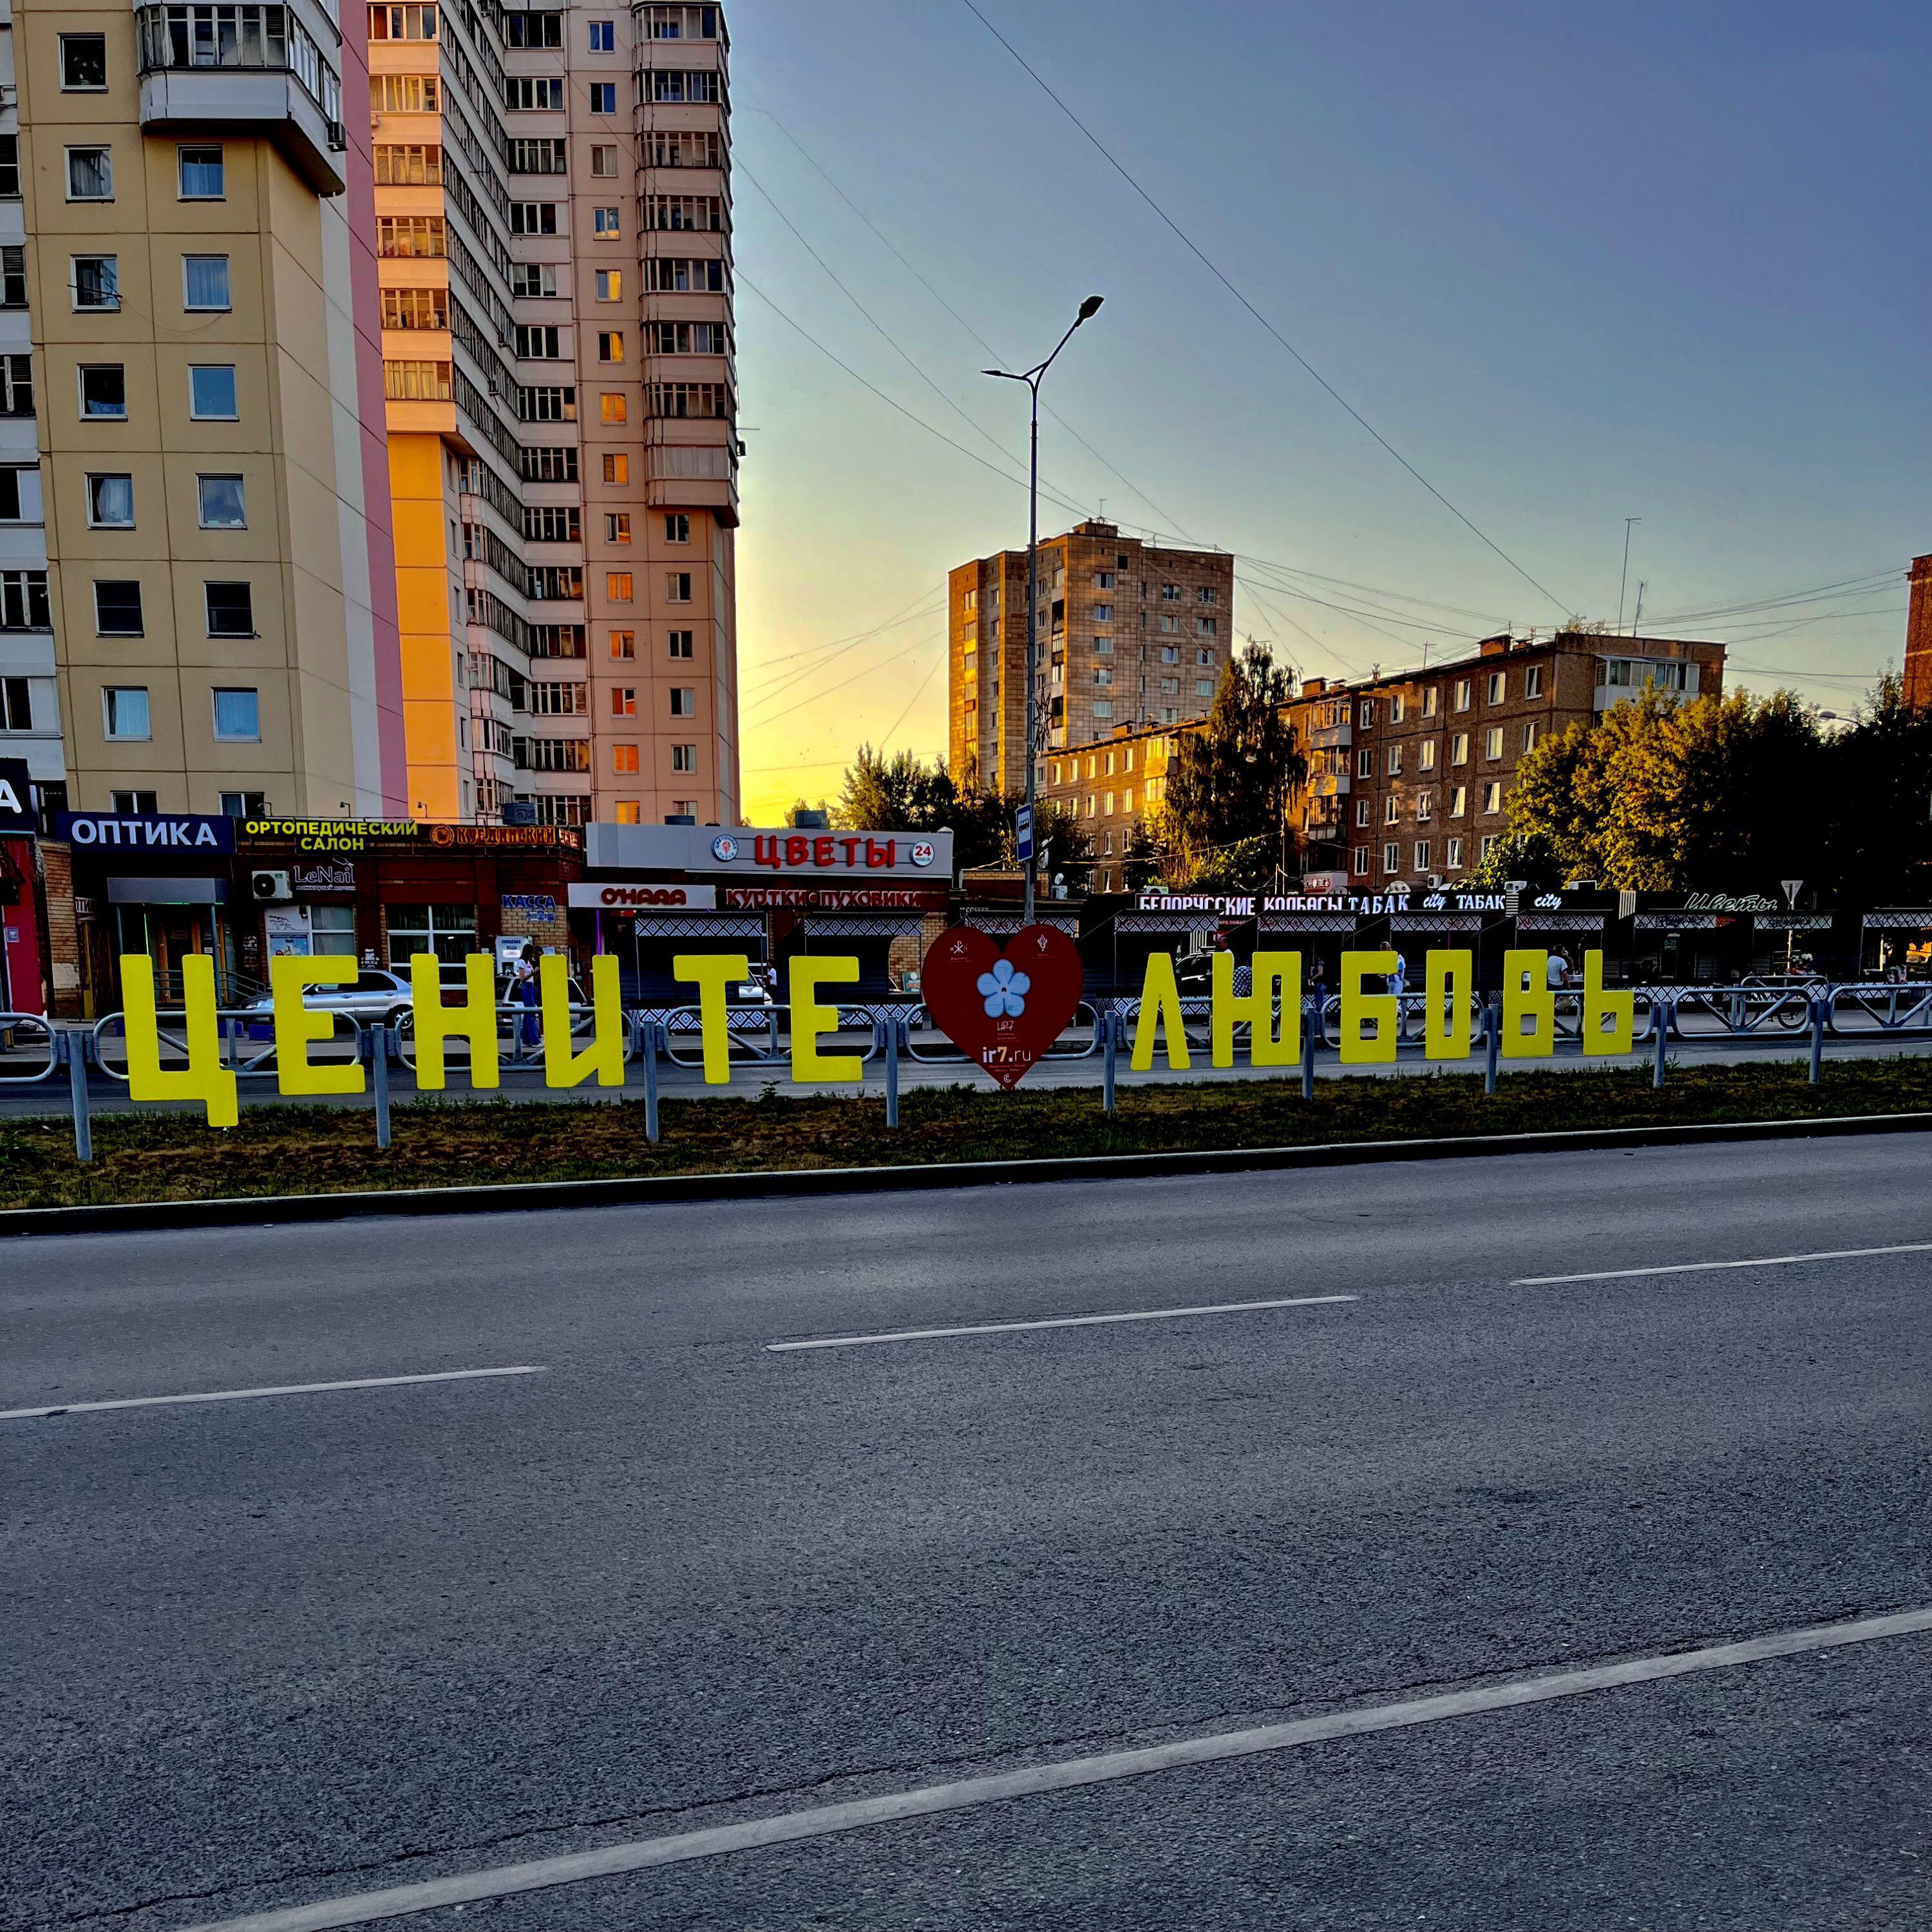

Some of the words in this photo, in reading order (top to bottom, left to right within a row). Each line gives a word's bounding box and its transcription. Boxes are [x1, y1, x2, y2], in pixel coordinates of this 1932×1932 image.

[71, 819, 218, 846] ОПТИКА
[245, 820, 418, 837] ОРТОПЕДИЧЕСКИЙ
[457, 826, 556, 844] КУЕДИНСКИЙ
[301, 837, 364, 850] САЛОН
[755, 835, 896, 868] ЦВЕТЫ
[915, 846, 931, 856] 24
[293, 866, 355, 883] LeNail
[502, 895, 557, 909] КАССА
[726, 889, 808, 909] КУРТКИ
[819, 891, 923, 910] ПУХОВИКИ
[1139, 896, 1256, 916] БЕЛОРУССКИЕ
[1264, 896, 1343, 911] КОЛБАСЫ
[1348, 895, 1410, 914] ТАБАК
[1423, 893, 1446, 911] city
[1455, 895, 1506, 909] ТАБАК
[1533, 893, 1562, 911] city
[1683, 892, 1777, 912] Цветы
[119, 953, 864, 1128] ЦЕНИТЕ
[1130, 949, 1636, 1070] ЛЮБОВЬ
[983, 1046, 1031, 1063] ir7.ru
